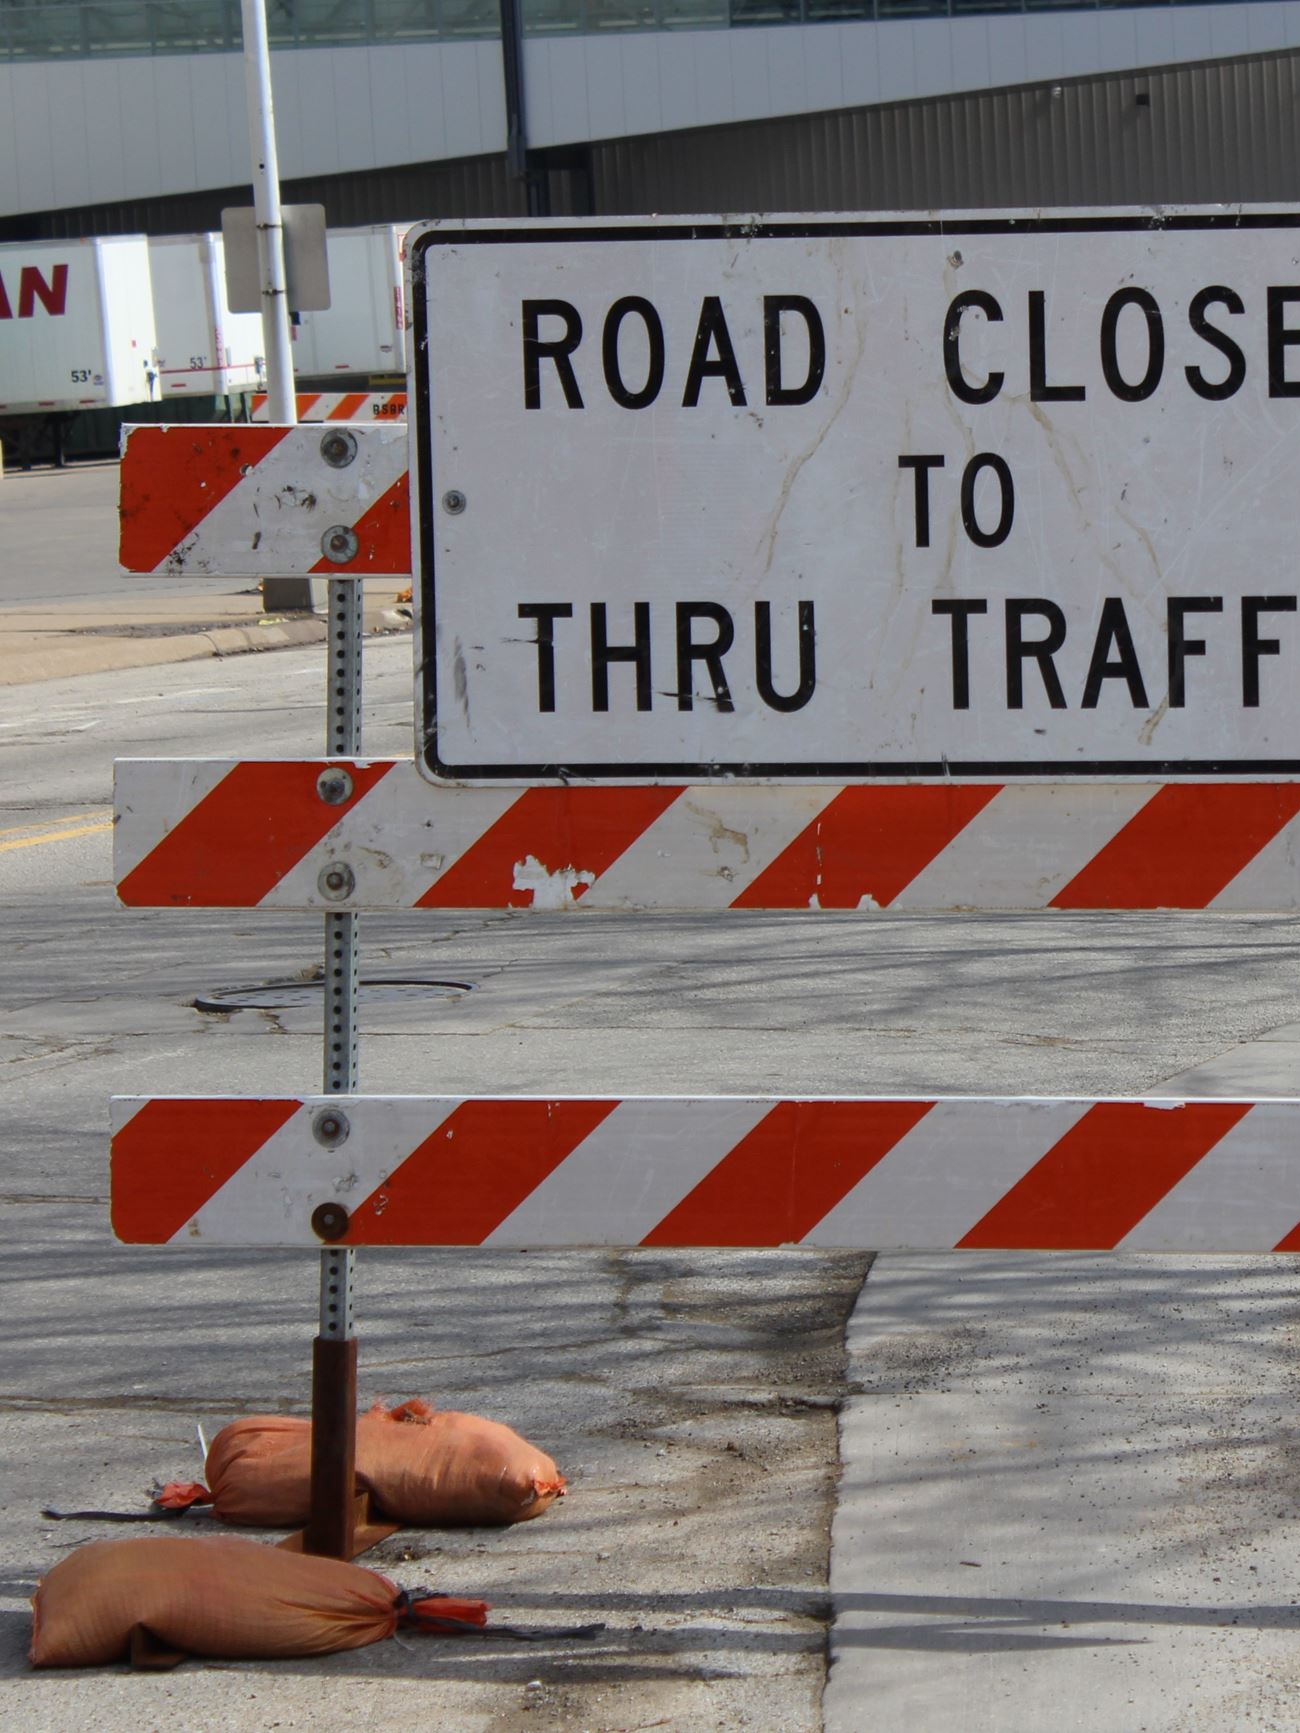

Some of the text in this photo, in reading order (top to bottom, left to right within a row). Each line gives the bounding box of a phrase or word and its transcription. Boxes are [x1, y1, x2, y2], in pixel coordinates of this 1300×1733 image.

[0, 264, 69, 320] N
[71, 370, 92, 383] 53'
[522, 294, 826, 411] ROAD
[898, 452, 1014, 549] TO
[517, 600, 817, 714] THRU
